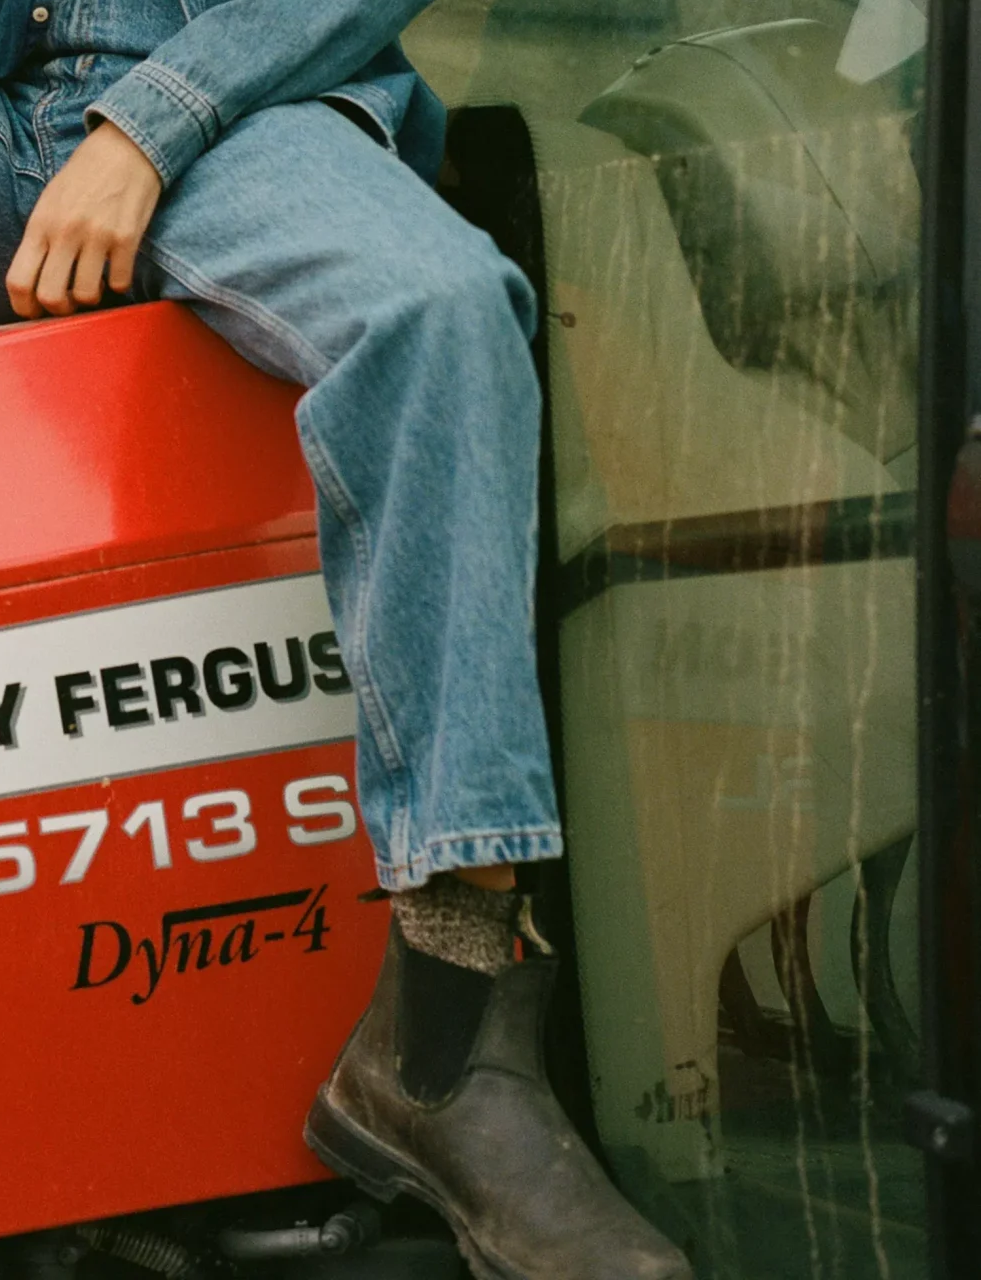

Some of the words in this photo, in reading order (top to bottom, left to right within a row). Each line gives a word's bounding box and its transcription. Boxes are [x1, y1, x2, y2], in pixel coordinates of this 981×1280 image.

[54, 630, 353, 737] FERGUS
[283, 775, 357, 847] S
[69, 884, 332, 1006] Dyna-4
